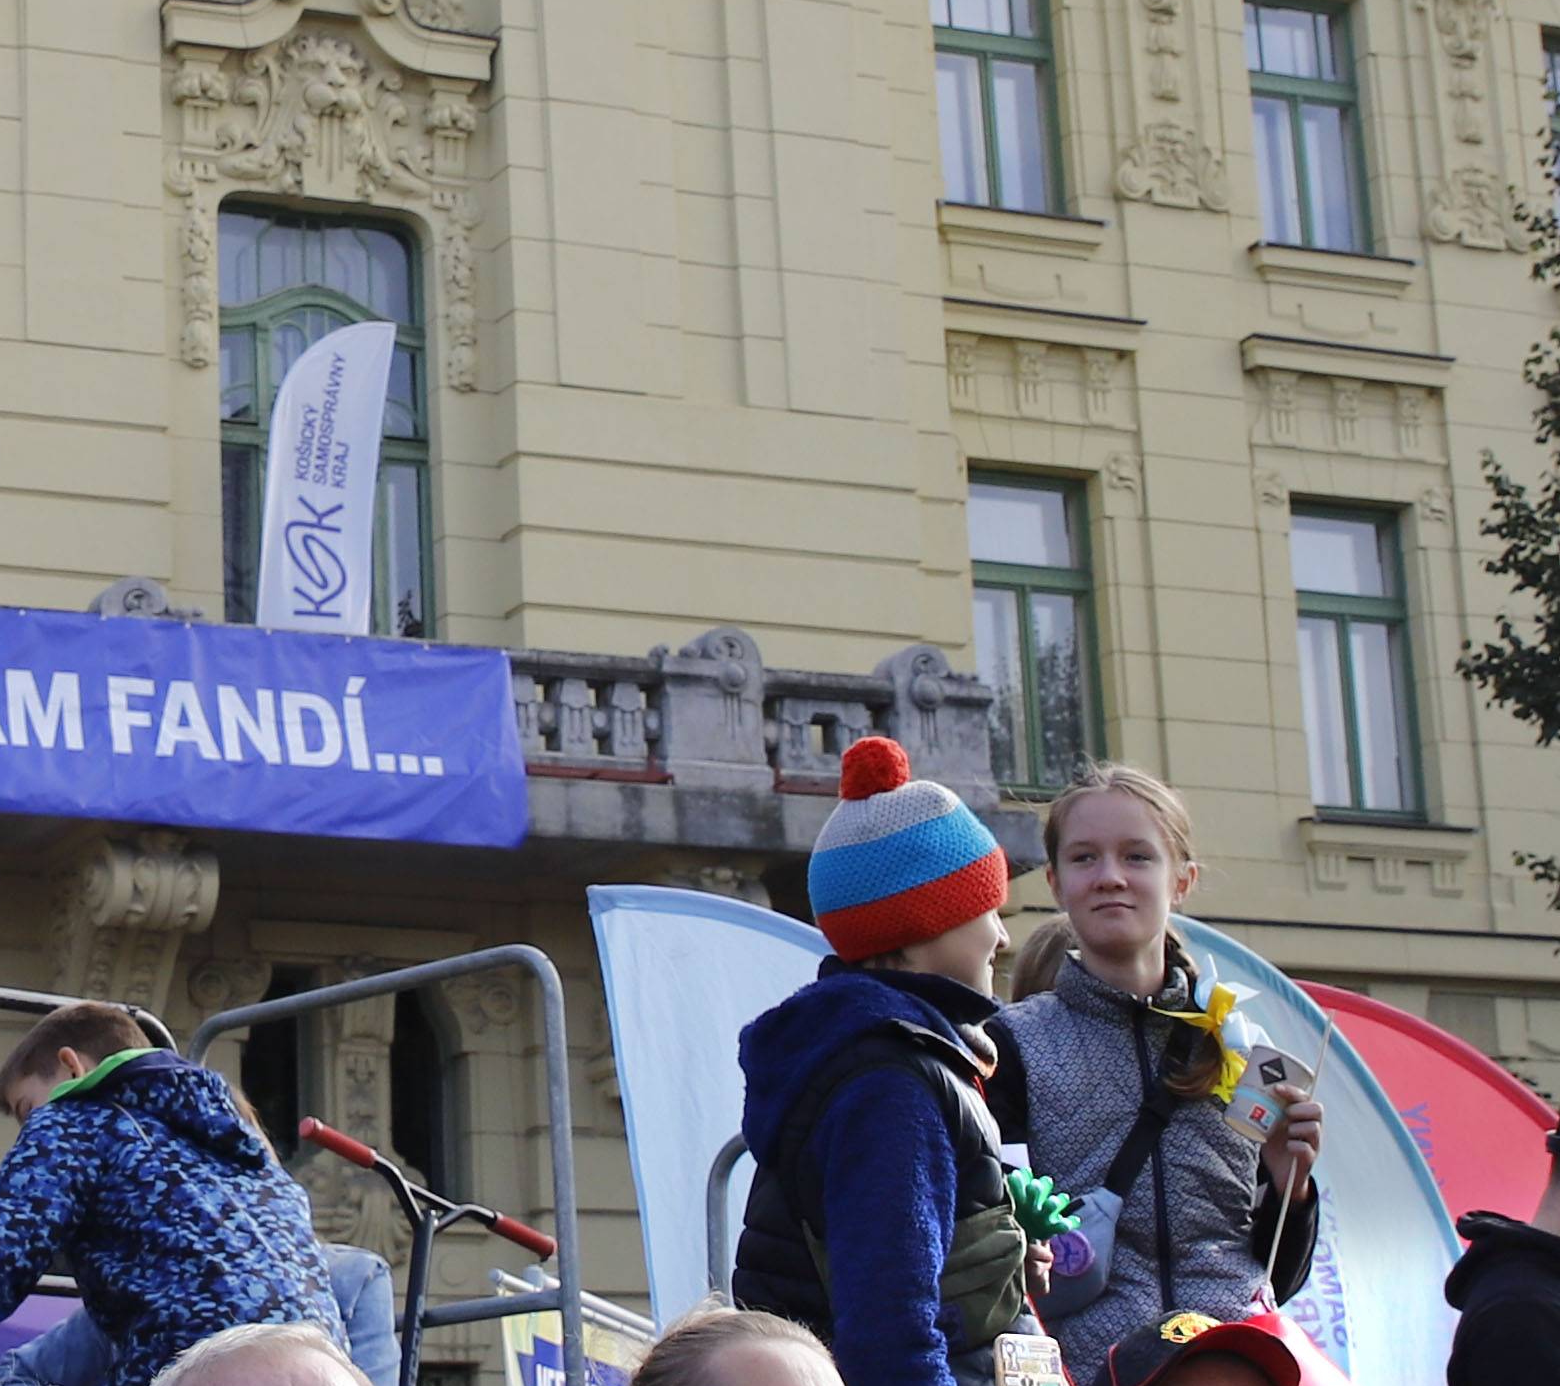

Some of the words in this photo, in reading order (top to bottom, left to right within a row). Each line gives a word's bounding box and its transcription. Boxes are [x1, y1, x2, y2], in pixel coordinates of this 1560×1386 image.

[294, 404, 319, 481] KOŠICKÝ
[312, 351, 346, 486] SAMOSPRÁVNY
[331, 442, 351, 489] KRAJ
[106, 676, 444, 776] FANDÍ...
